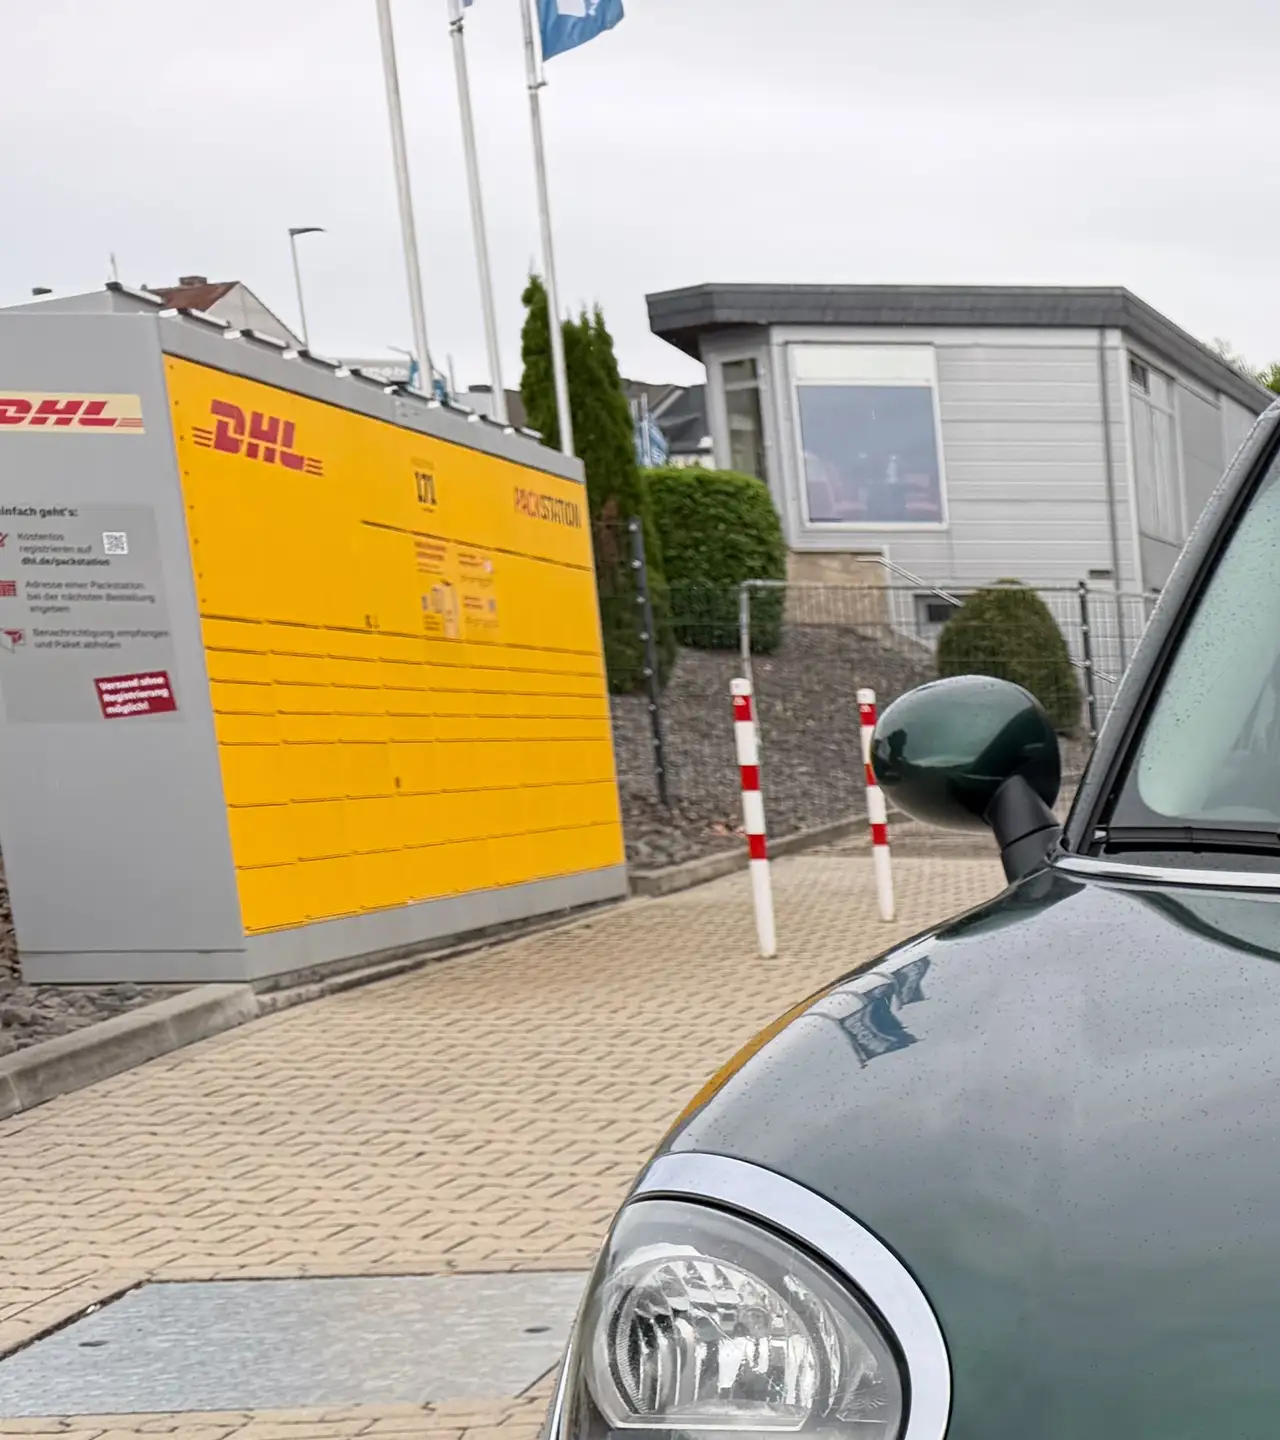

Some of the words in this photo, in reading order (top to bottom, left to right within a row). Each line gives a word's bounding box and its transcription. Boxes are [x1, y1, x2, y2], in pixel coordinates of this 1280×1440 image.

[0, 399, 118, 426] DHL
[210, 399, 304, 471] DHL
[0, 506, 37, 516] infach
[39, 507, 78, 519] geht's:
[514, 488, 582, 529] PACKSTATION
[17, 533, 64, 541] Kostenlos
[19, 545, 74, 555] registrieren
[76, 545, 92, 554] auf
[21, 557, 110, 567] dhl.de/packstation
[25, 581, 62, 589] Adresse
[98, 678, 139, 691] Versand
